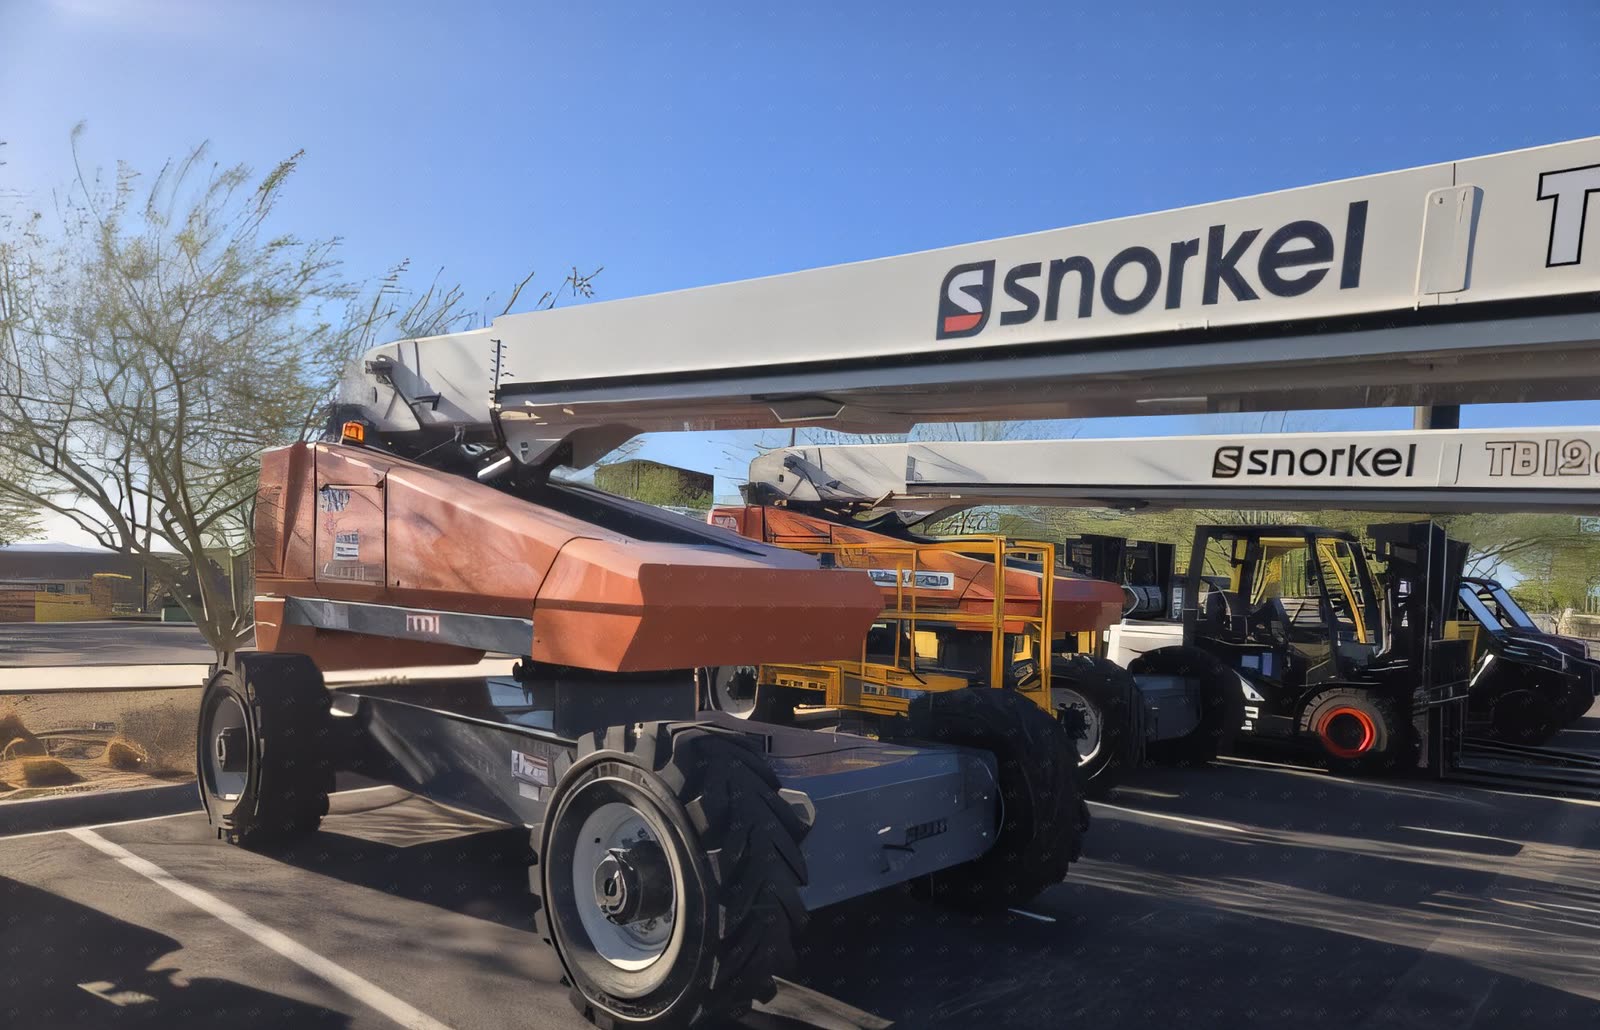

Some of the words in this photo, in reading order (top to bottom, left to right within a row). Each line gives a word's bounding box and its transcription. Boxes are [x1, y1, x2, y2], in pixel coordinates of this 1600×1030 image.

[1000, 200, 1369, 326] snorkel
[1247, 443, 1417, 477] snorkel
[1485, 438, 1600, 476] TB12
